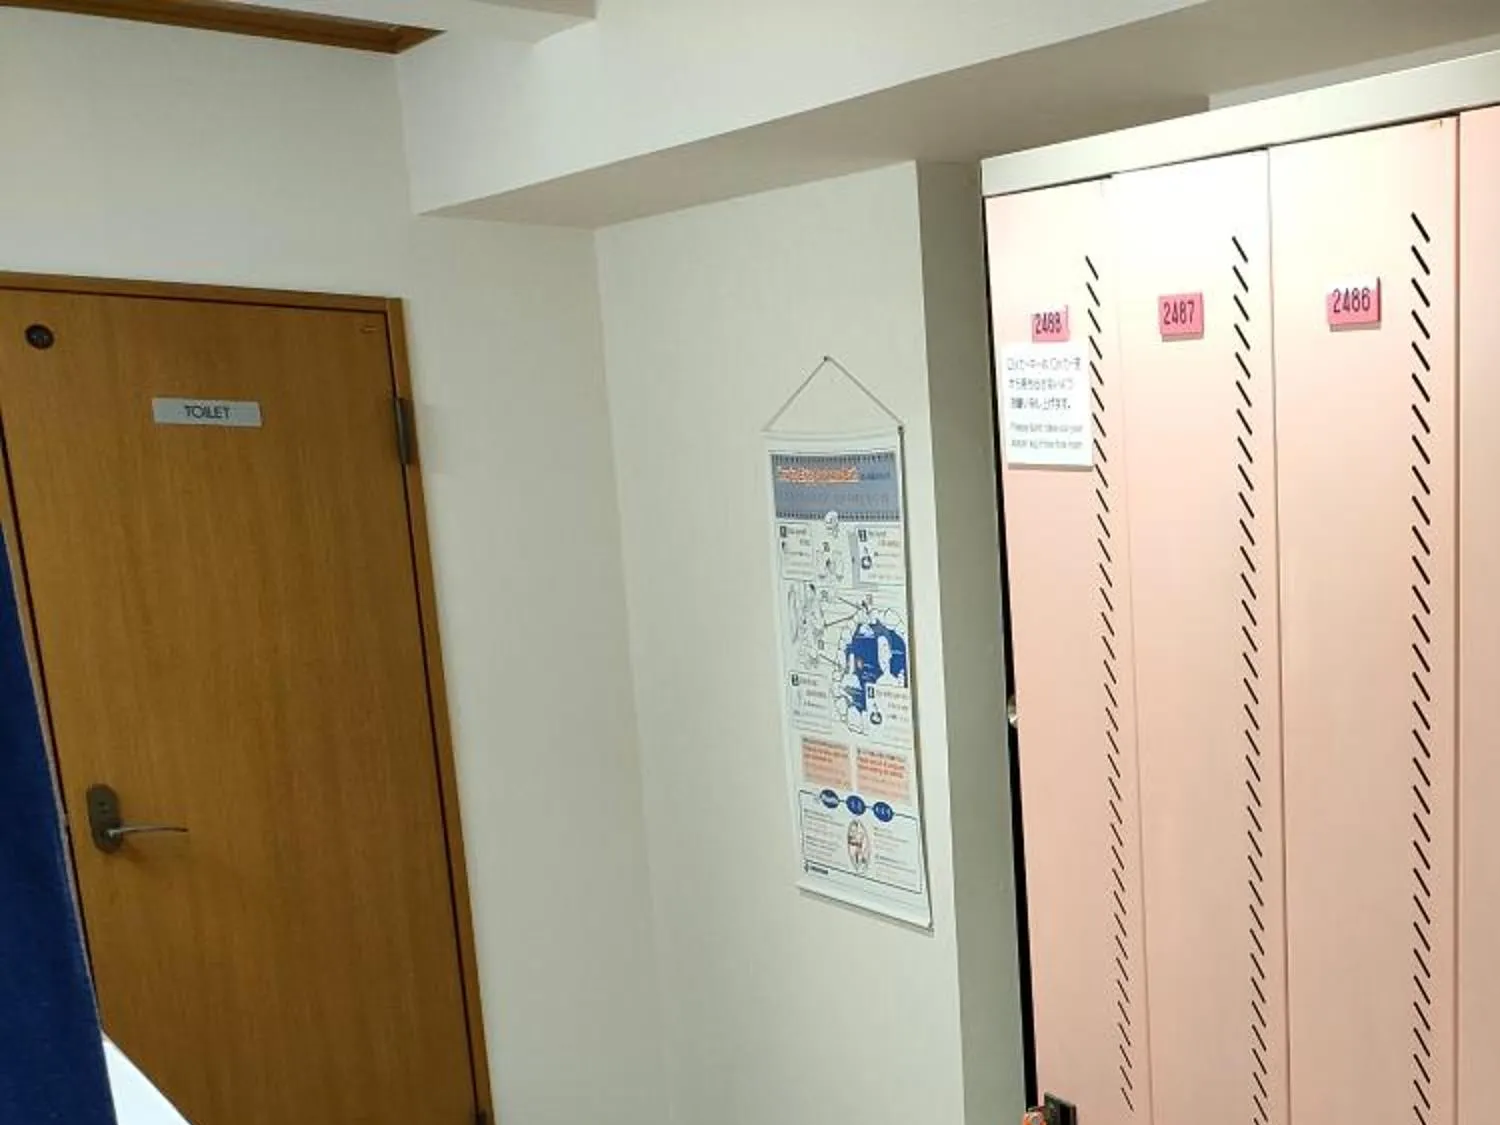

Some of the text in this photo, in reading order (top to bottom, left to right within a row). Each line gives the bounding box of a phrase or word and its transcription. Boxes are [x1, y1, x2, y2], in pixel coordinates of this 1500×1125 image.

[1163, 299, 1195, 325] 2487
[1331, 287, 1371, 313] 2486
[184, 404, 231, 419] TOILET
